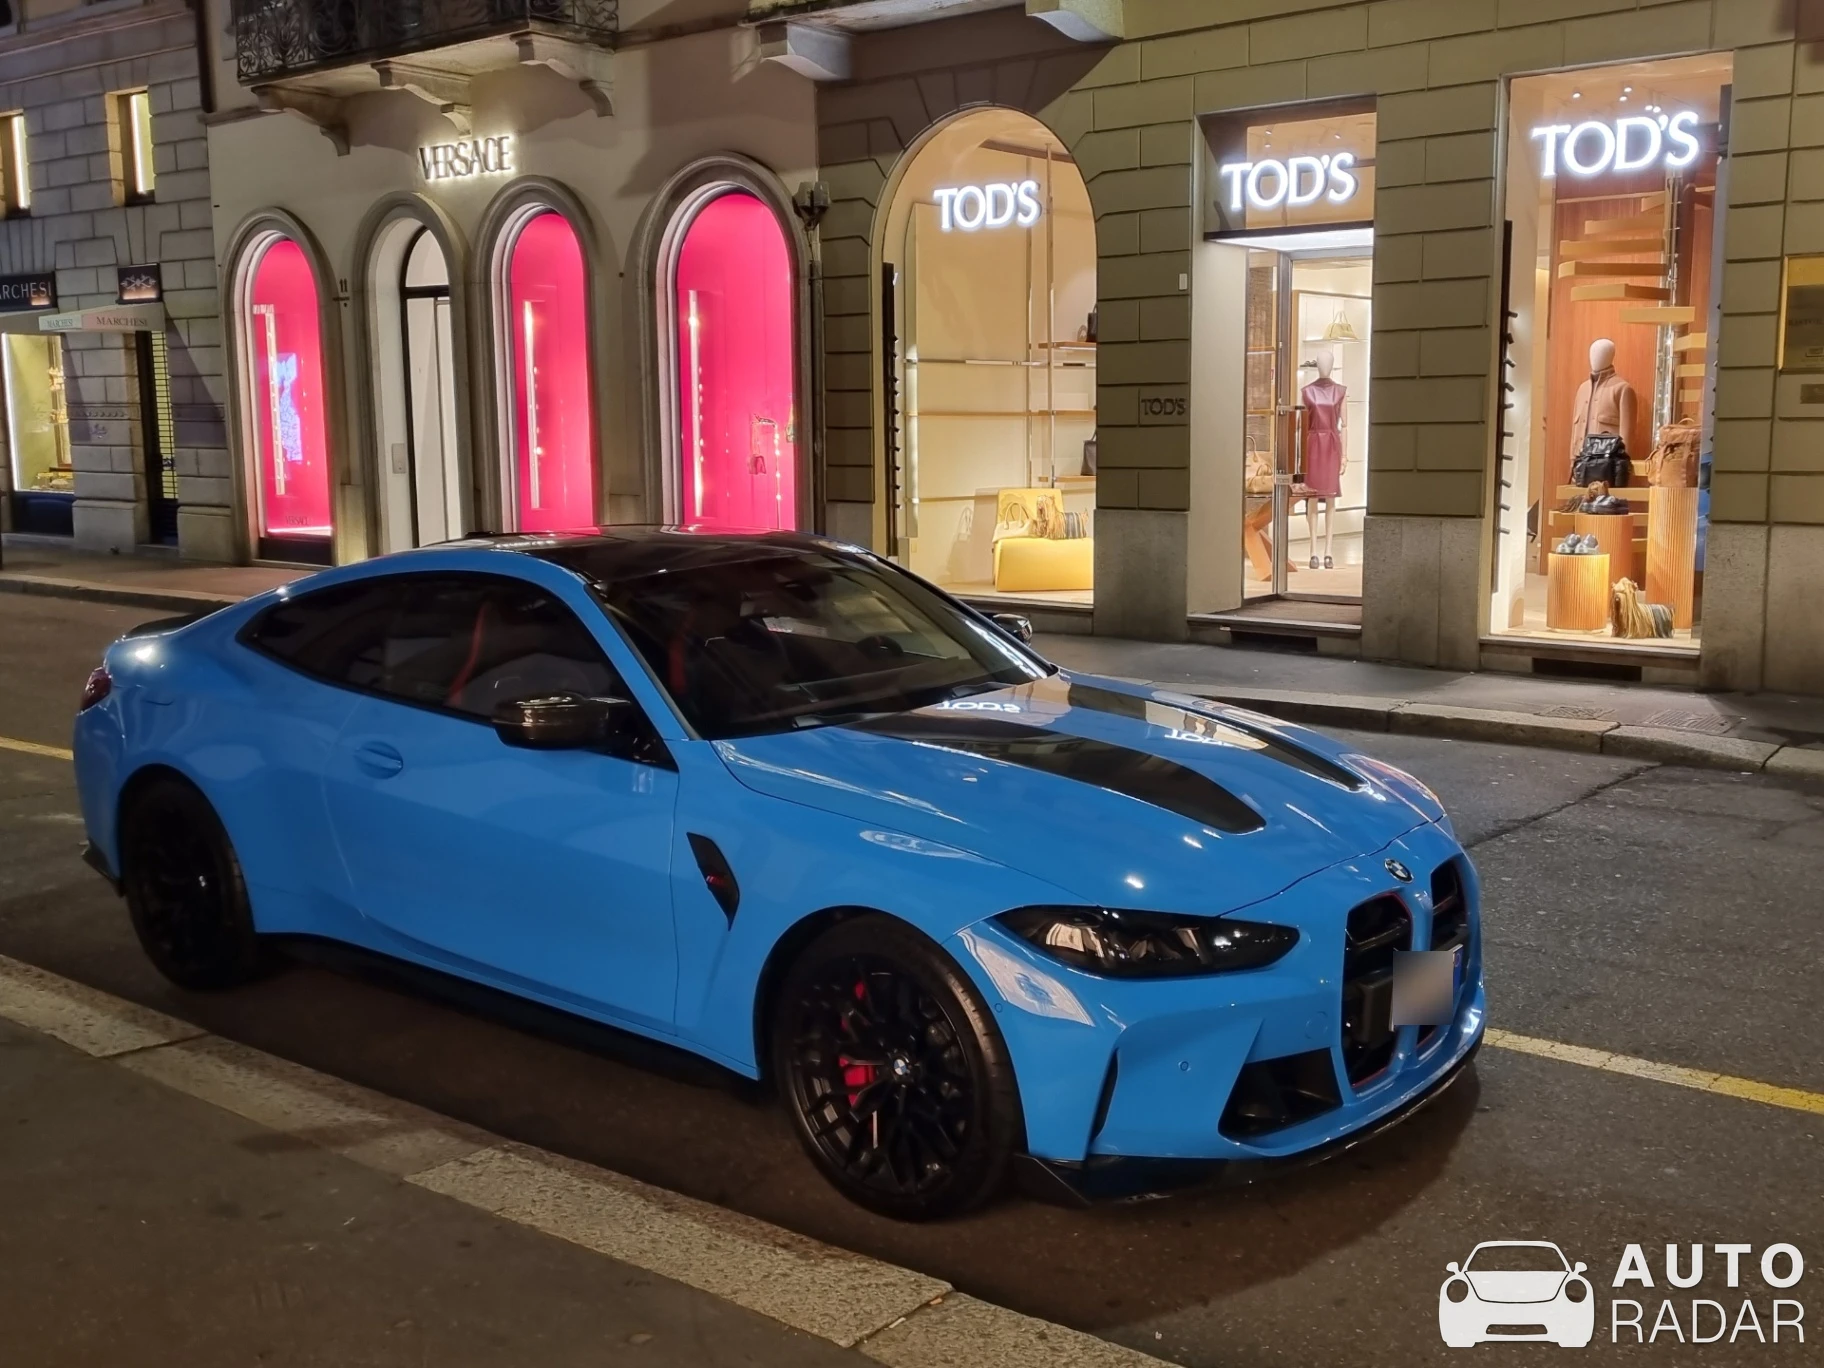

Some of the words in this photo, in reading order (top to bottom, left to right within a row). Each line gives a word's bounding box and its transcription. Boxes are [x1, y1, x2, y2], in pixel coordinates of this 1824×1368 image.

[418, 136, 512, 180] VERSACE
[1531, 111, 1699, 177] TOD'S
[933, 180, 1041, 230] TOD'S
[1220, 152, 1358, 211] TOD'S
[96, 316, 149, 327] MARCHESI
[1141, 397, 1186, 416] TOD'S
